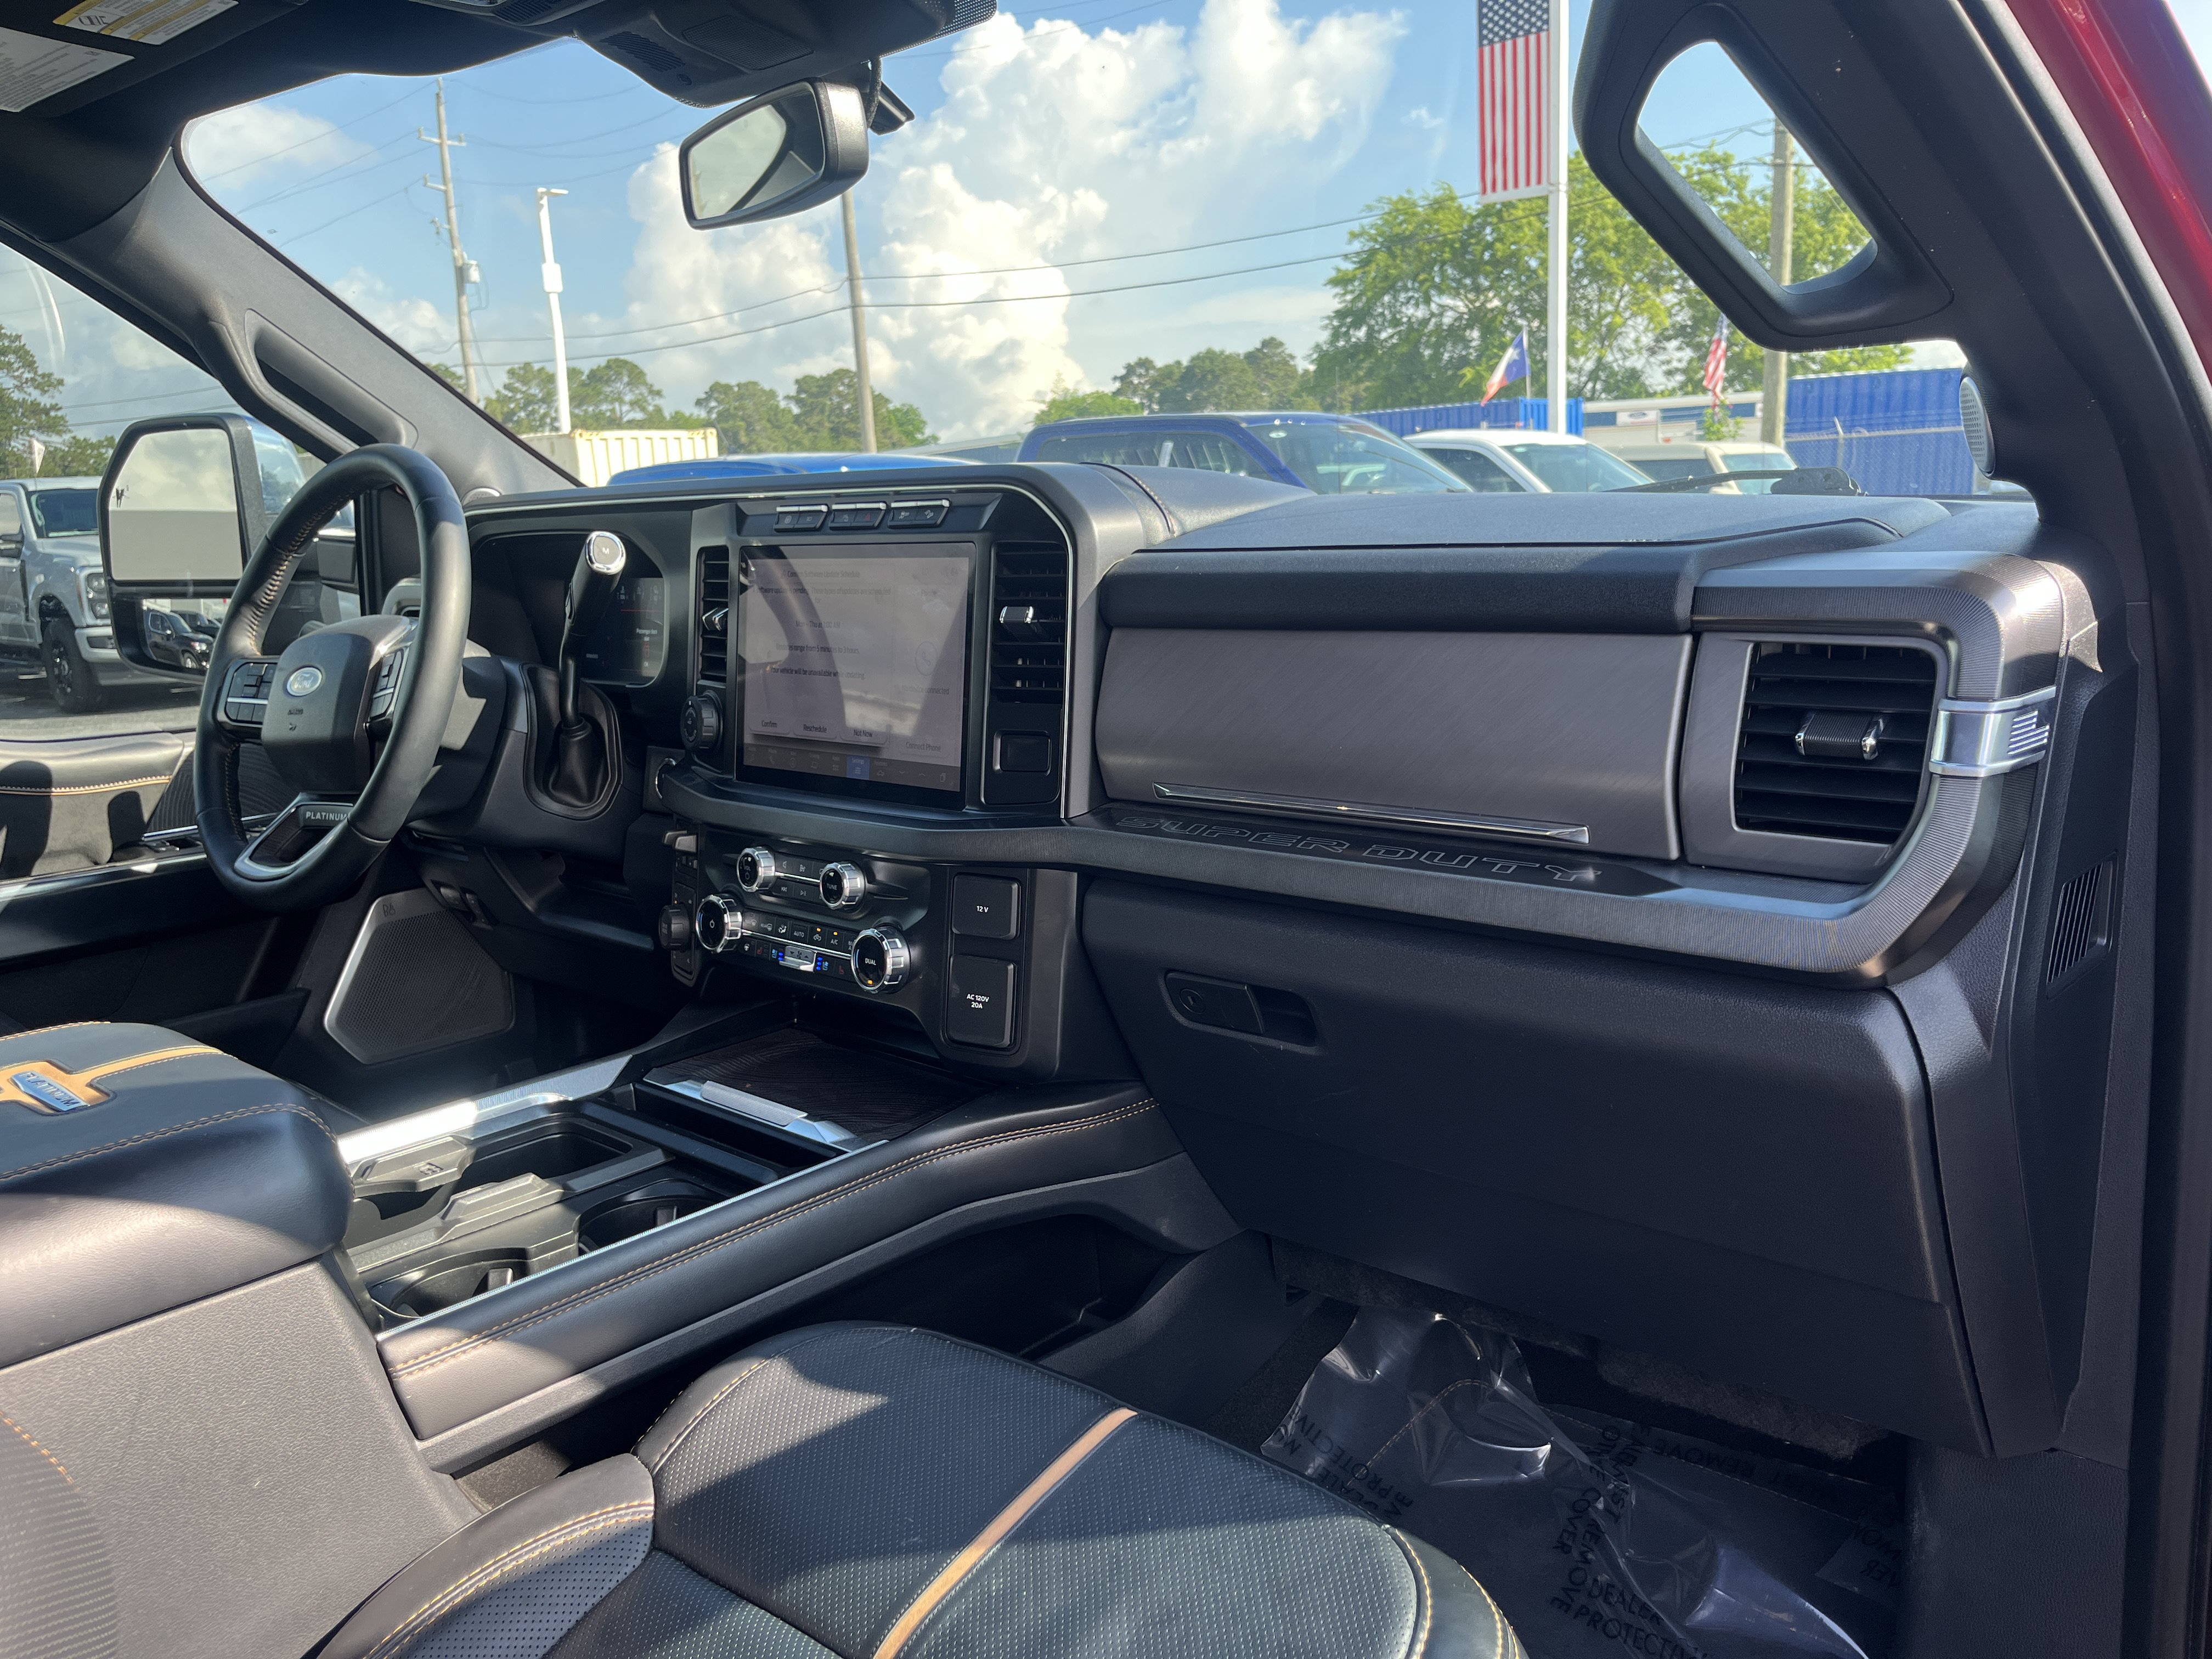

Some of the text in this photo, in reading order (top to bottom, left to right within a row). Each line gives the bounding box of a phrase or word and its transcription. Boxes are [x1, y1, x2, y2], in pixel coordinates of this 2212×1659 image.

[761, 720, 778, 728] Confirm
[803, 724, 827, 733] Reschedule
[853, 729, 873, 738] Not Now
[905, 741, 941, 752] Connect Phone
[306, 811, 347, 821] PLATINUM
[1115, 816, 1601, 882] SUPER DUTY
[827, 883, 838, 891] TUNE
[865, 957, 877, 966] DUAL
[19, 1071, 80, 1107] PLATINUM
